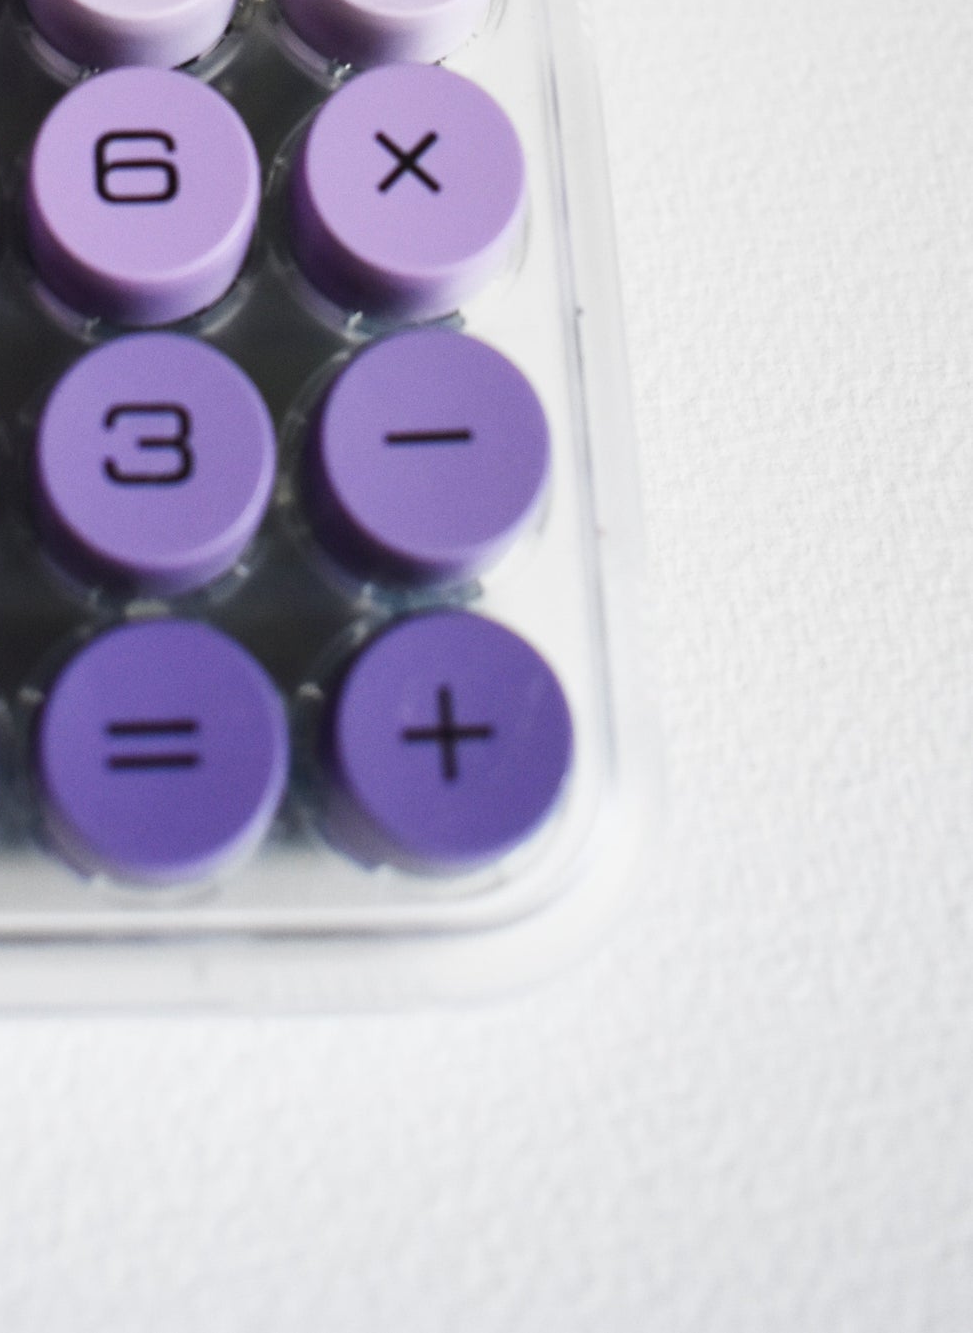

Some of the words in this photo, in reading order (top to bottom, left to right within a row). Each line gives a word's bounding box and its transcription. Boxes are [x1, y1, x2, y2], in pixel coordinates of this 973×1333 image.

[93, 129, 180, 205] 6
[103, 402, 196, 487] 3
[105, 718, 203, 773] =
[401, 686, 497, 784] +
